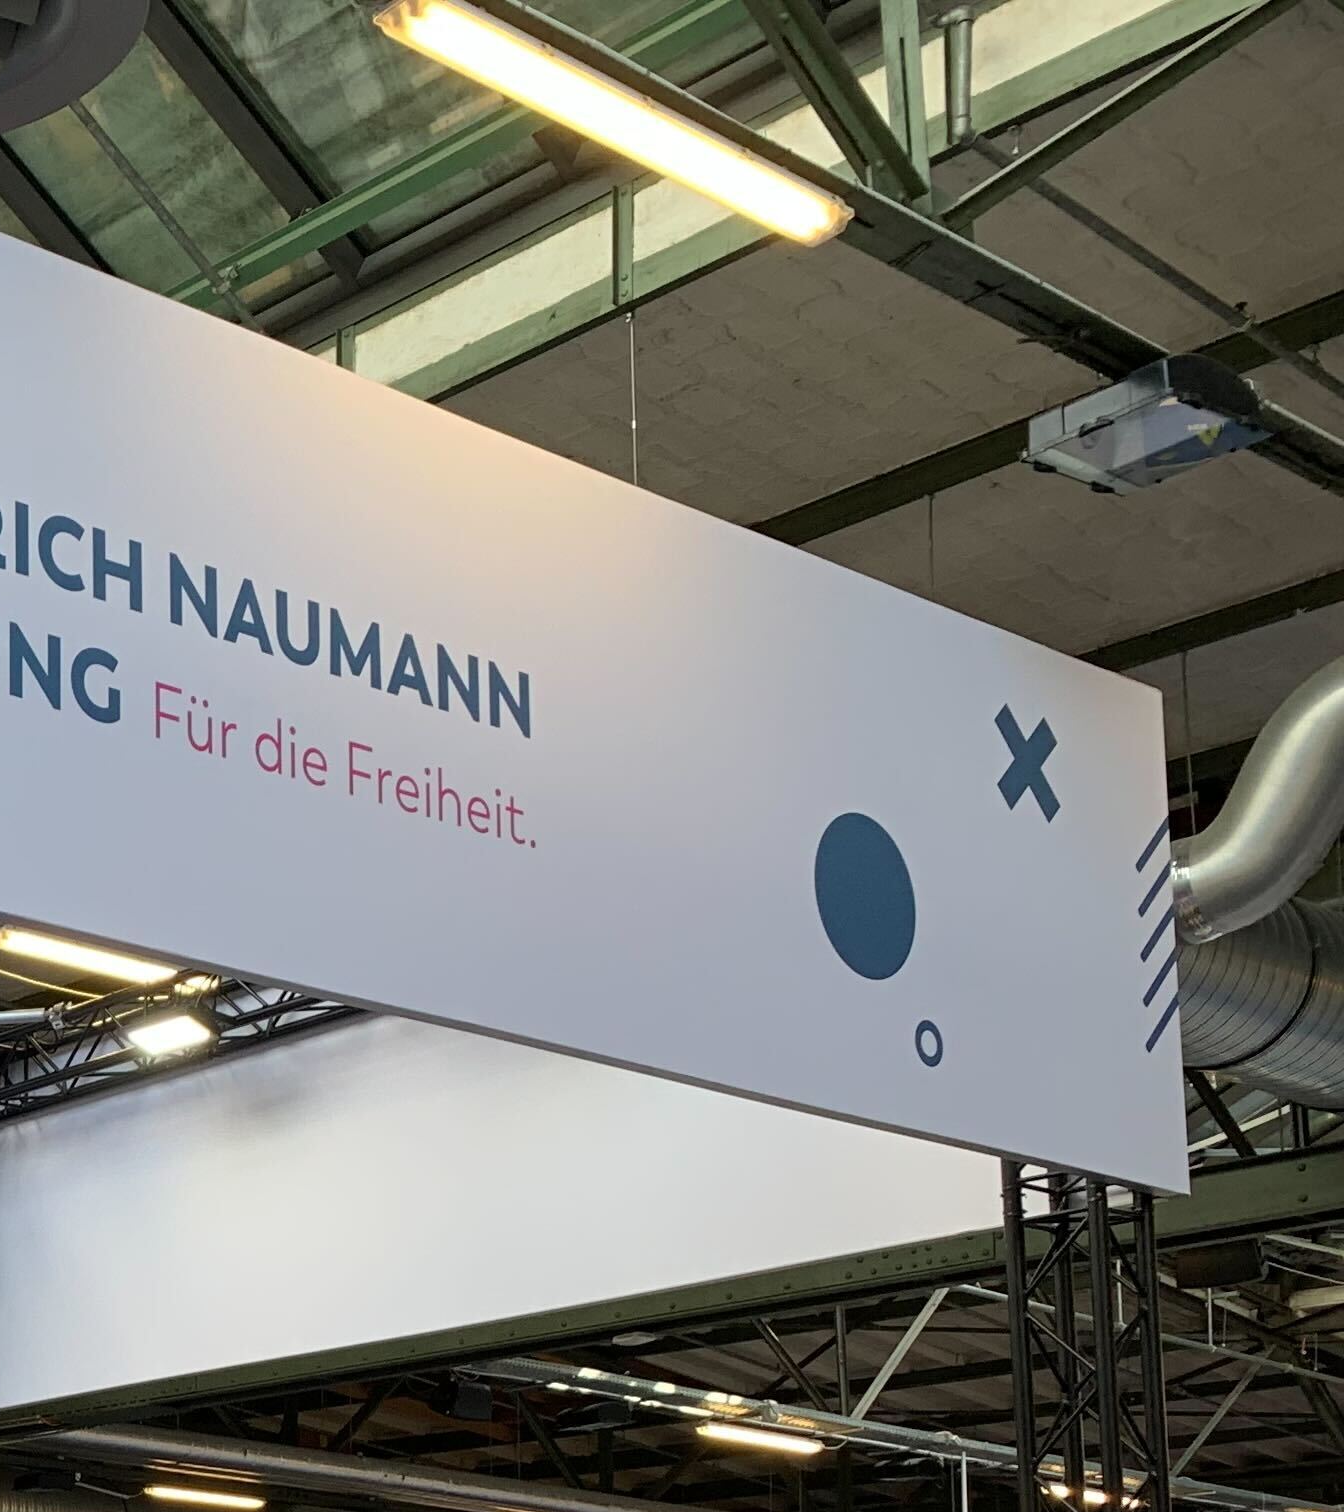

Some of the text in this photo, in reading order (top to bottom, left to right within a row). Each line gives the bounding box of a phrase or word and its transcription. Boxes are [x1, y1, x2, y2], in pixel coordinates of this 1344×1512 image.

[168, 551, 531, 740] NAUMANN
[154, 680, 238, 759] Für
[254, 717, 328, 787] die
[348, 740, 538, 850] Freiheit.
